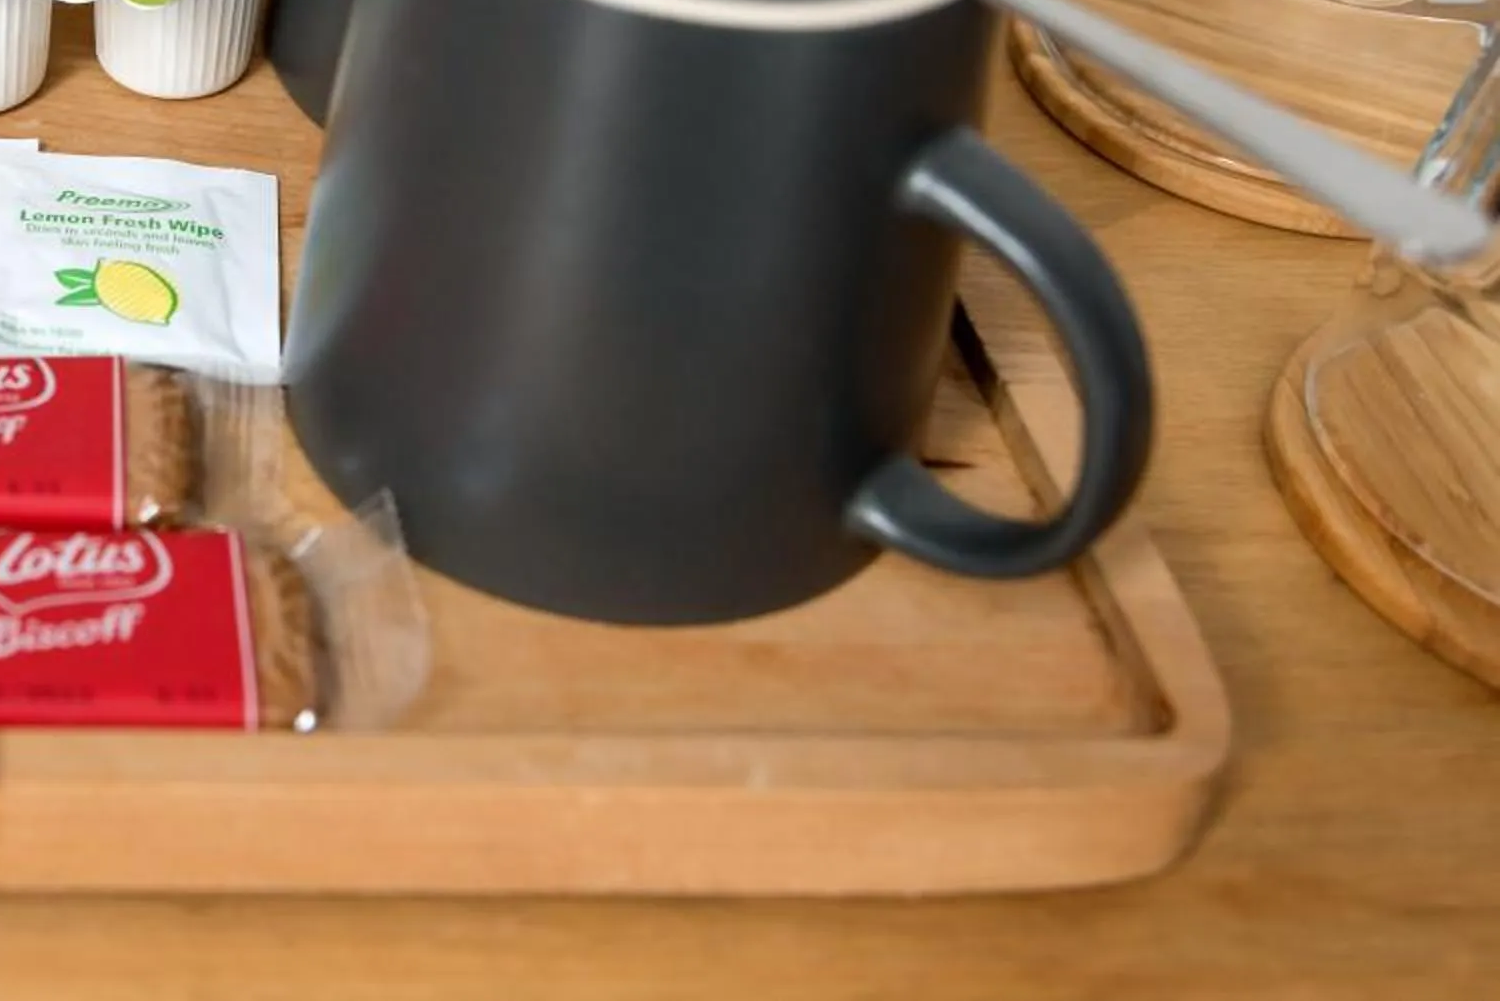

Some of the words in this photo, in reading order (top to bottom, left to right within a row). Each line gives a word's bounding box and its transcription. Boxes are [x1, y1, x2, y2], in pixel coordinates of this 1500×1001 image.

[56, 190, 160, 209] Preema
[20, 209, 94, 225] Lemon
[103, 213, 161, 230] Fresh
[169, 219, 224, 240] Wipe
